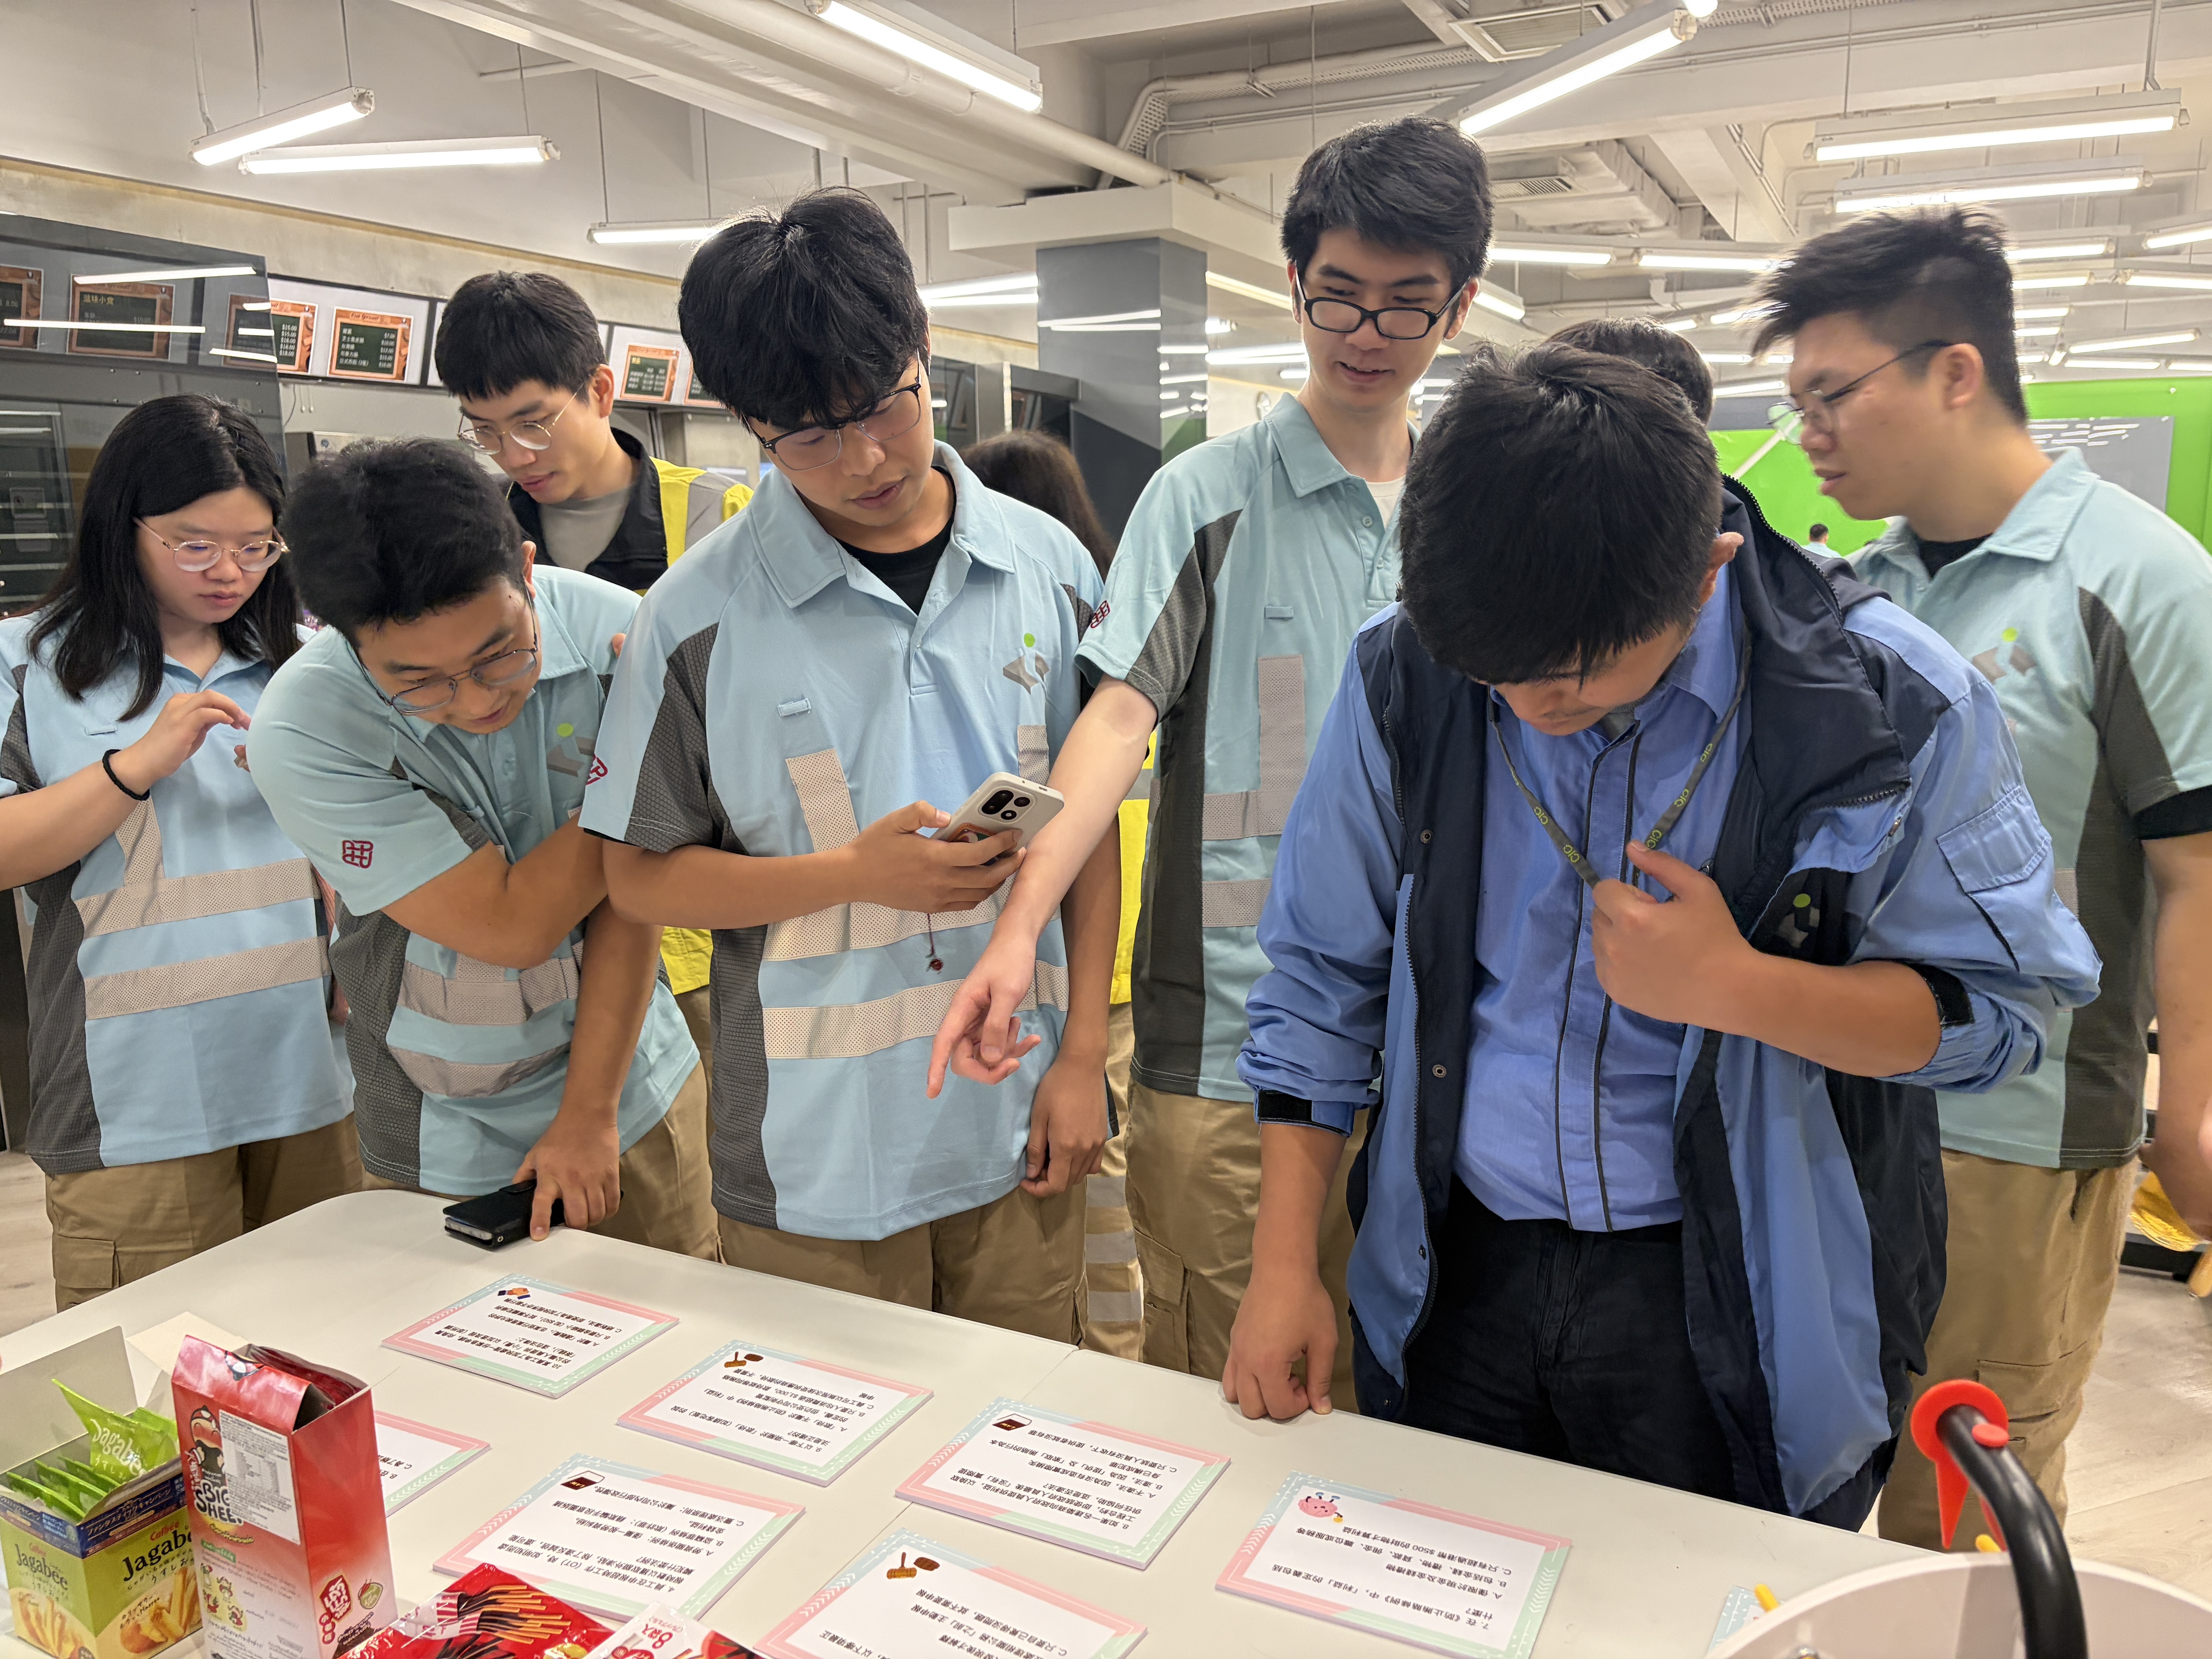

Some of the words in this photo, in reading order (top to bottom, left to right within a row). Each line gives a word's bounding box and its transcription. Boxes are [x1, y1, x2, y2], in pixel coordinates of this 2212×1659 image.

[1700, 743, 1713, 763] CIC
[1674, 788, 1689, 807] CIC
[1534, 807, 1549, 825] CIC
[1563, 845, 1580, 863] CIC
[195, 1489, 243, 1524] SHEE
[150, 1520, 179, 1541] Calbee
[1342, 1526, 1410, 1549] 的財物才算利益
[1412, 1545, 1435, 1555] $500
[14, 1544, 69, 1590] Jagabee
[1437, 1551, 1499, 1572] 只有超過港幣
[642, 1623, 673, 1650] 8袋入
[1058, 1648, 1067, 1656] C.
